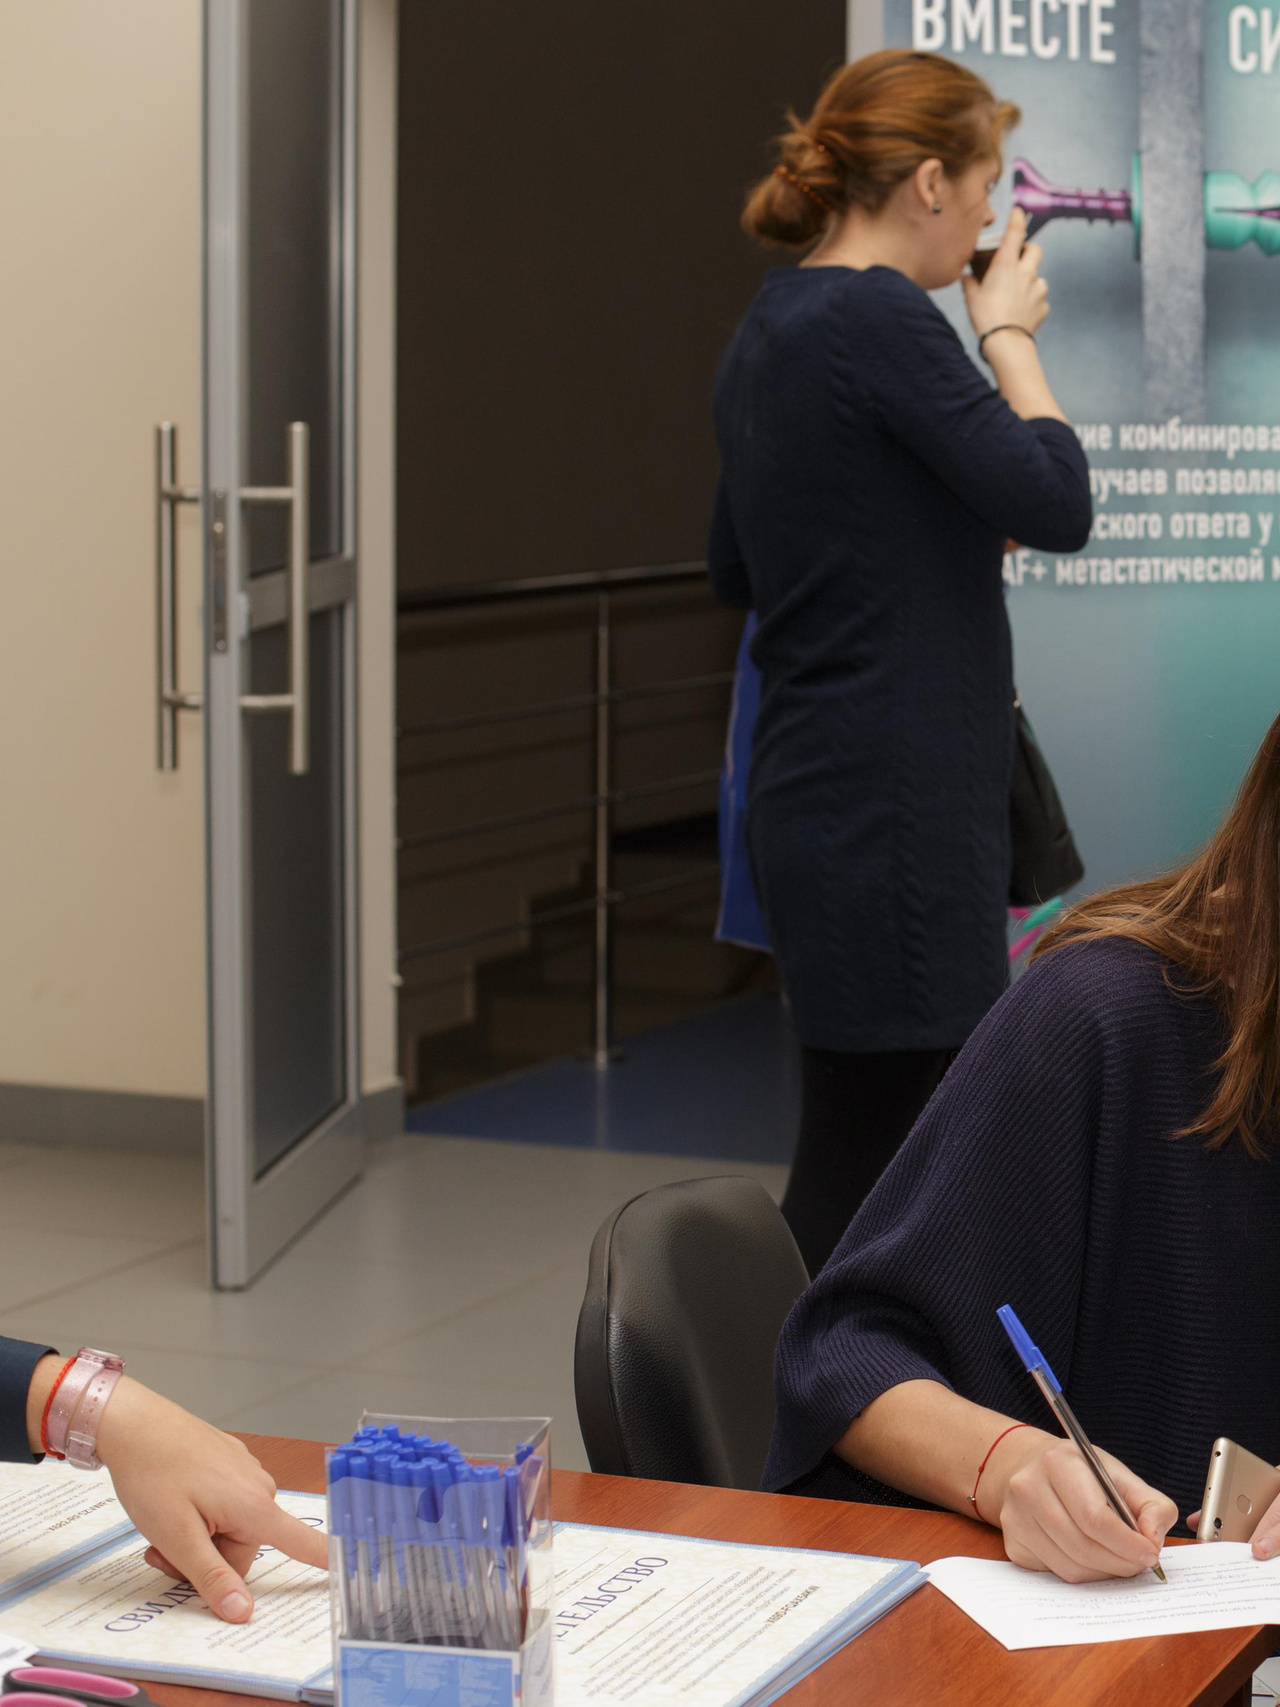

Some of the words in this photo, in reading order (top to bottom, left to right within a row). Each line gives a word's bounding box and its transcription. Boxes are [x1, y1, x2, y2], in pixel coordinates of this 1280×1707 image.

[912, 0, 1116, 64] ВМЕСТЕ
[1089, 512, 1163, 540] ского
[1169, 512, 1251, 539] ответа
[1257, 511, 1273, 547] у
[1055, 546, 1264, 586] метастатической
[554, 1556, 669, 1643] ТЕЛЬСТВО
